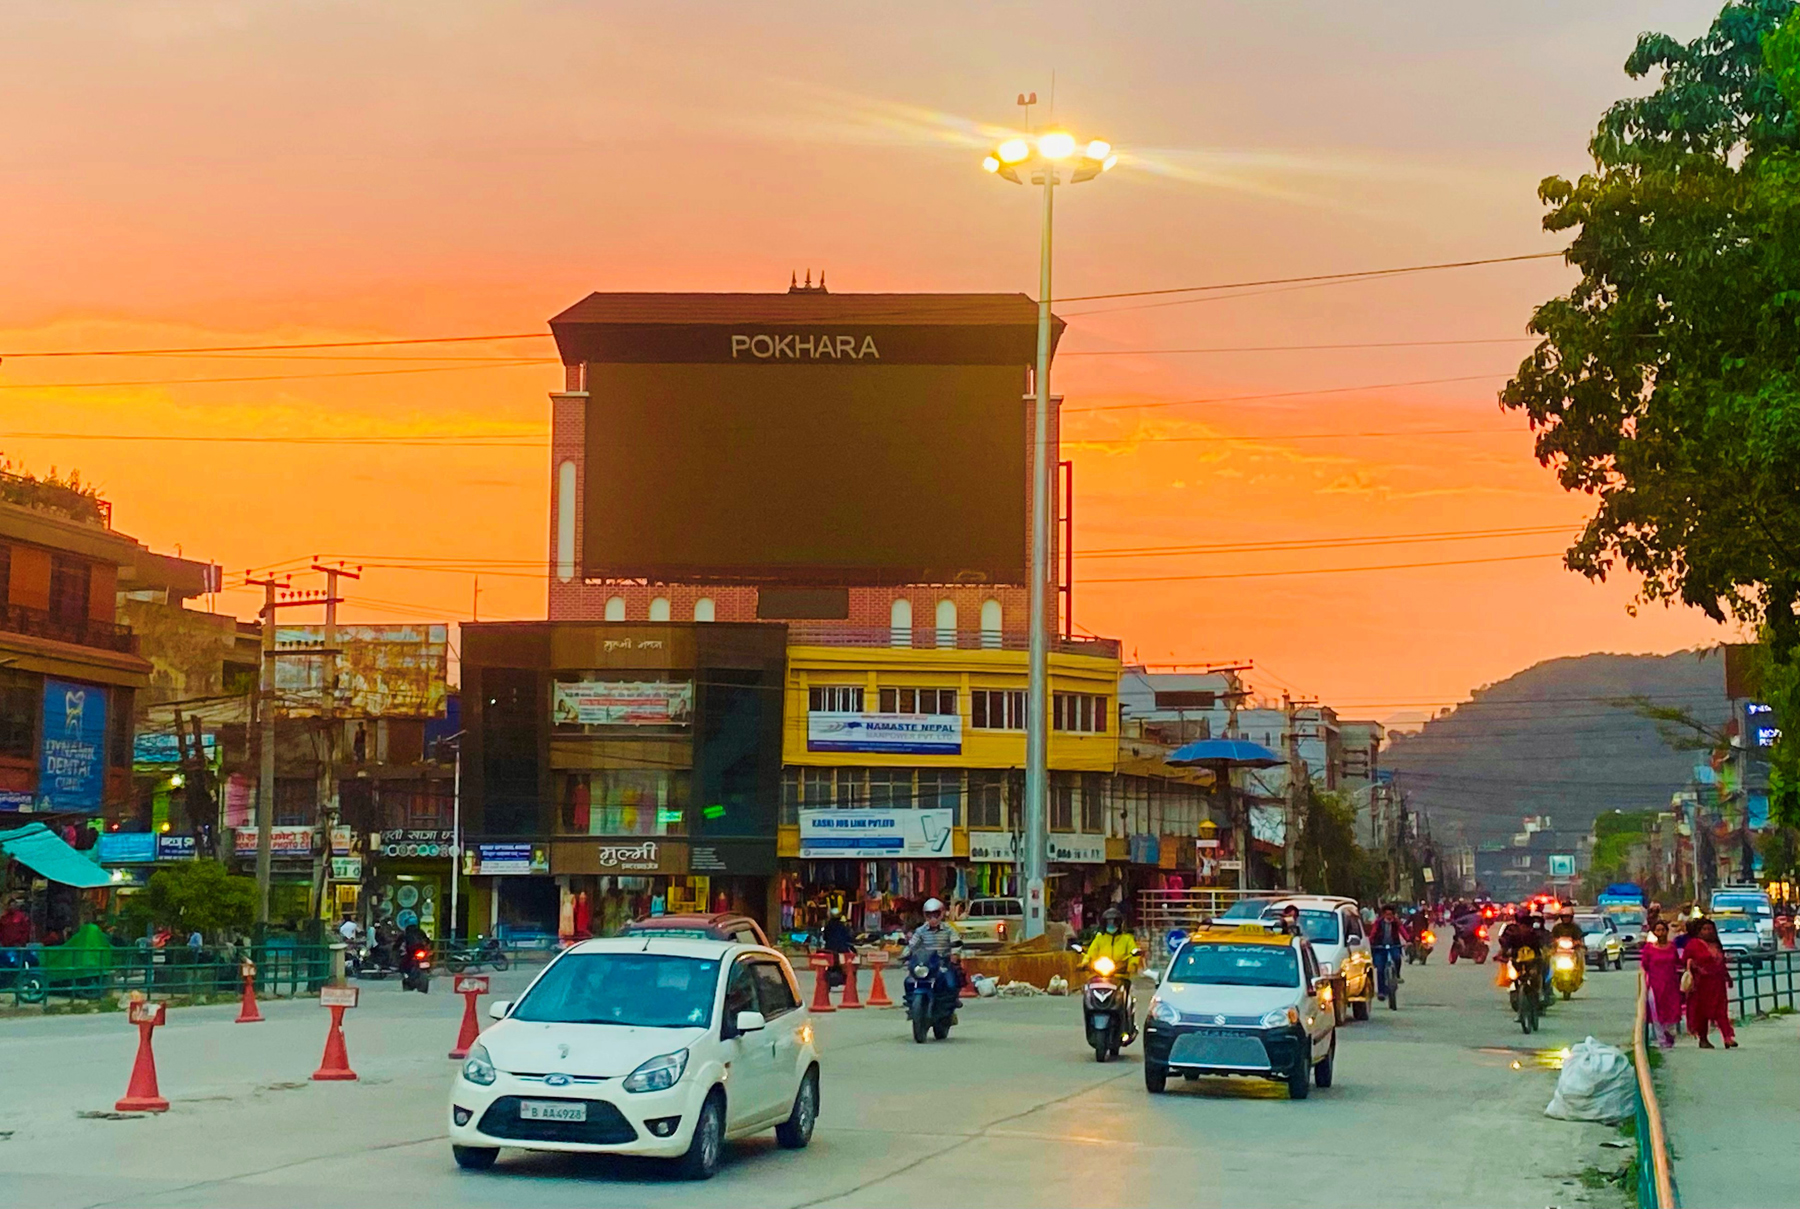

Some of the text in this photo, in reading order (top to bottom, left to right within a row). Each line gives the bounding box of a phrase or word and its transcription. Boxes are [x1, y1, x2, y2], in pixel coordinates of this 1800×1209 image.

[731, 334, 880, 359] POKHARA
[866, 722, 955, 732] NAMASTE NEPAL
[866, 732, 916, 740] MANPOWER
[47, 756, 94, 778] DENTAL
[55, 776, 85, 792] CLINIC
[812, 819, 834, 828] KASKI
[836, 819, 849, 828] JOB
[851, 819, 866, 828] LINK
[272, 841, 298, 849] PHOTO
[599, 841, 659, 867] मुल्मी
[531, 1107, 538, 1117] B
